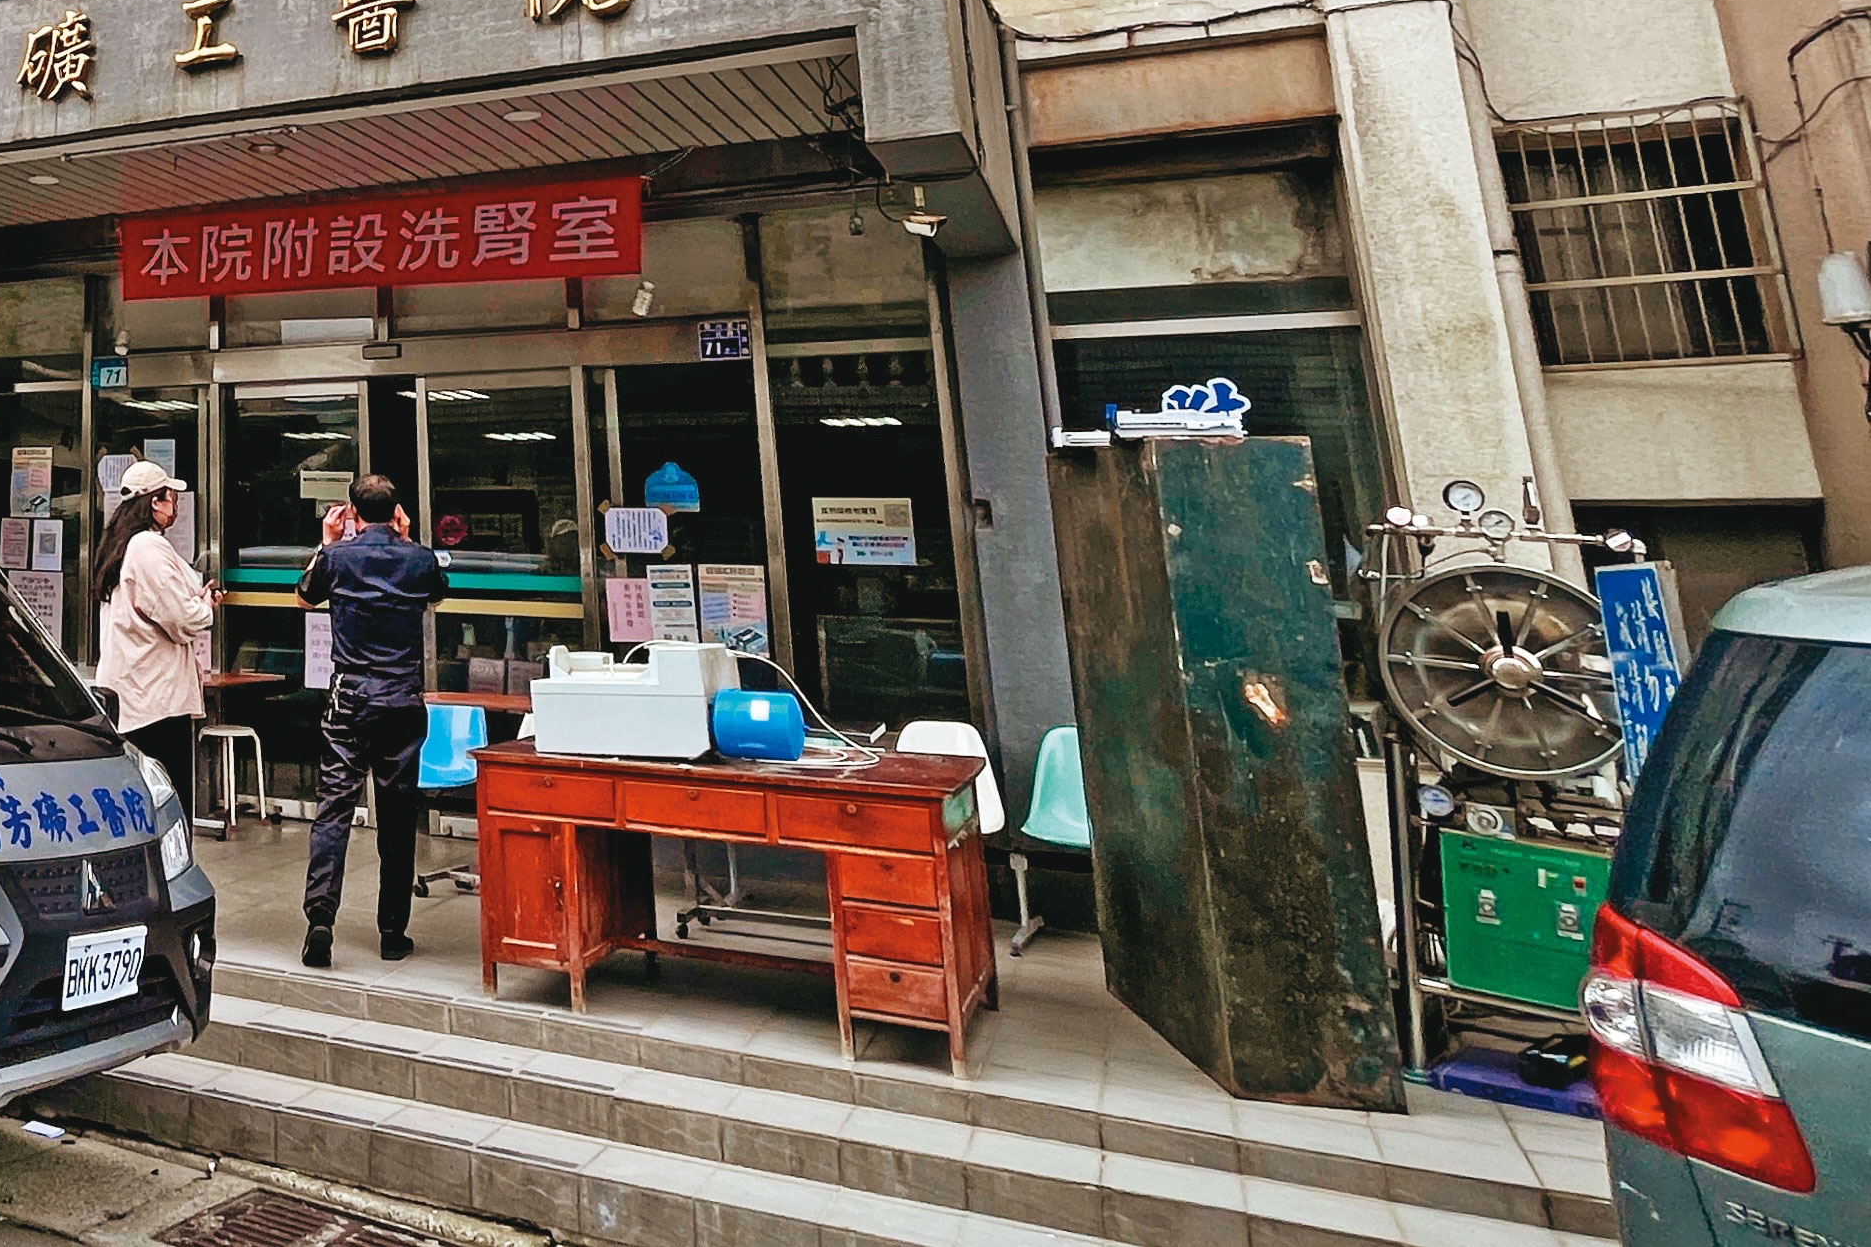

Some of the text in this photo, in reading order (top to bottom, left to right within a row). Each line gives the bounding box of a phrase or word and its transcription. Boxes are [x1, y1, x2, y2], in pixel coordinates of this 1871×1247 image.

[139, 195, 621, 285] 本院附設洗腎室
[106, 368, 122, 384] 71
[66, 947, 142, 999] BKK-3790
